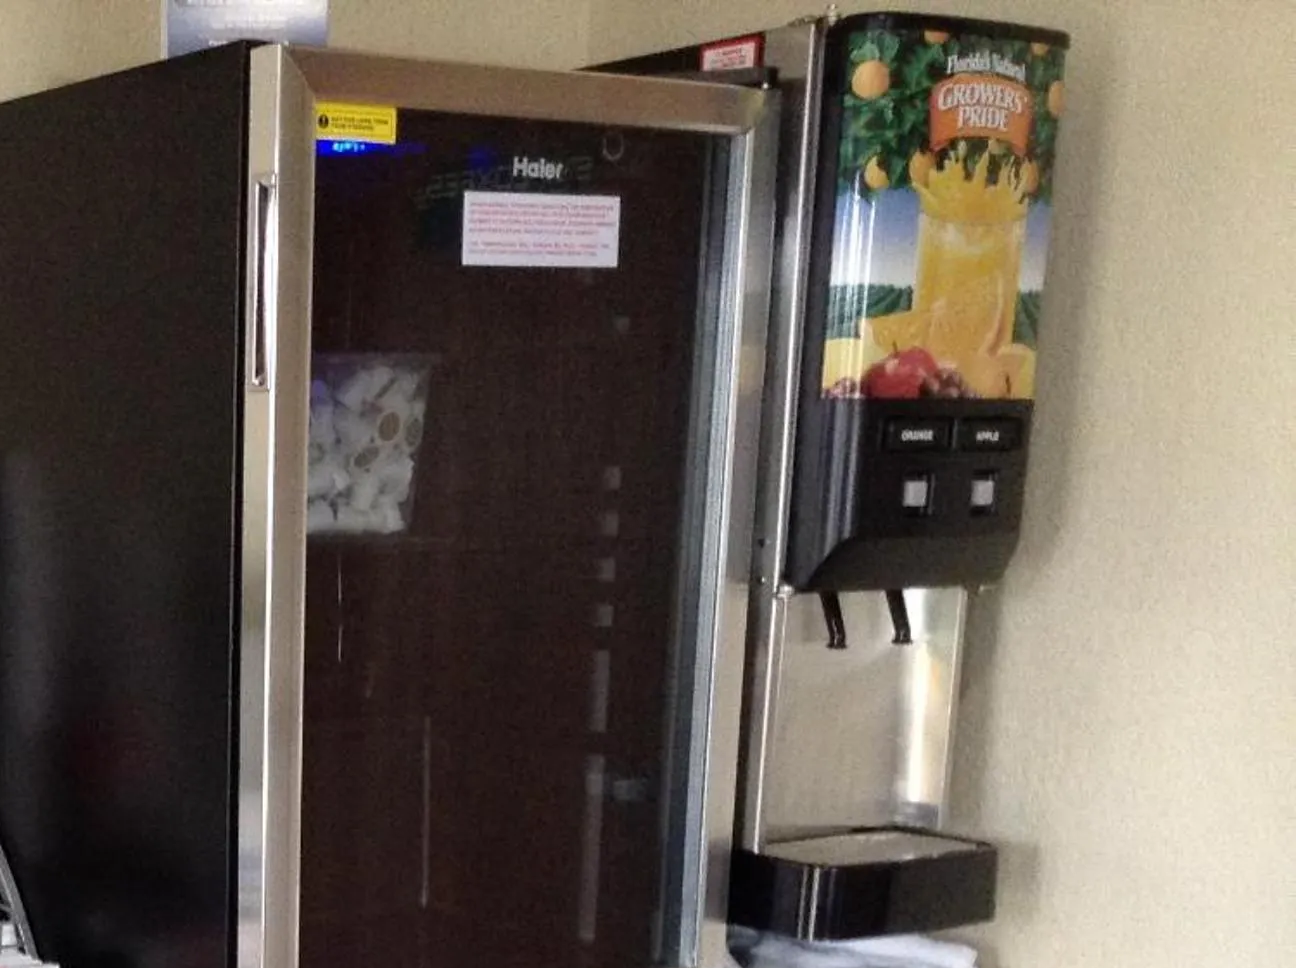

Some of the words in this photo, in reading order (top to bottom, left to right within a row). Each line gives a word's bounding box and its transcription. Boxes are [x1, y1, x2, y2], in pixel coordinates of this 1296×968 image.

[957, 105, 1009, 132] PRIDE
[512, 155, 564, 180] Haier
[976, 431, 1000, 442] APPLE
